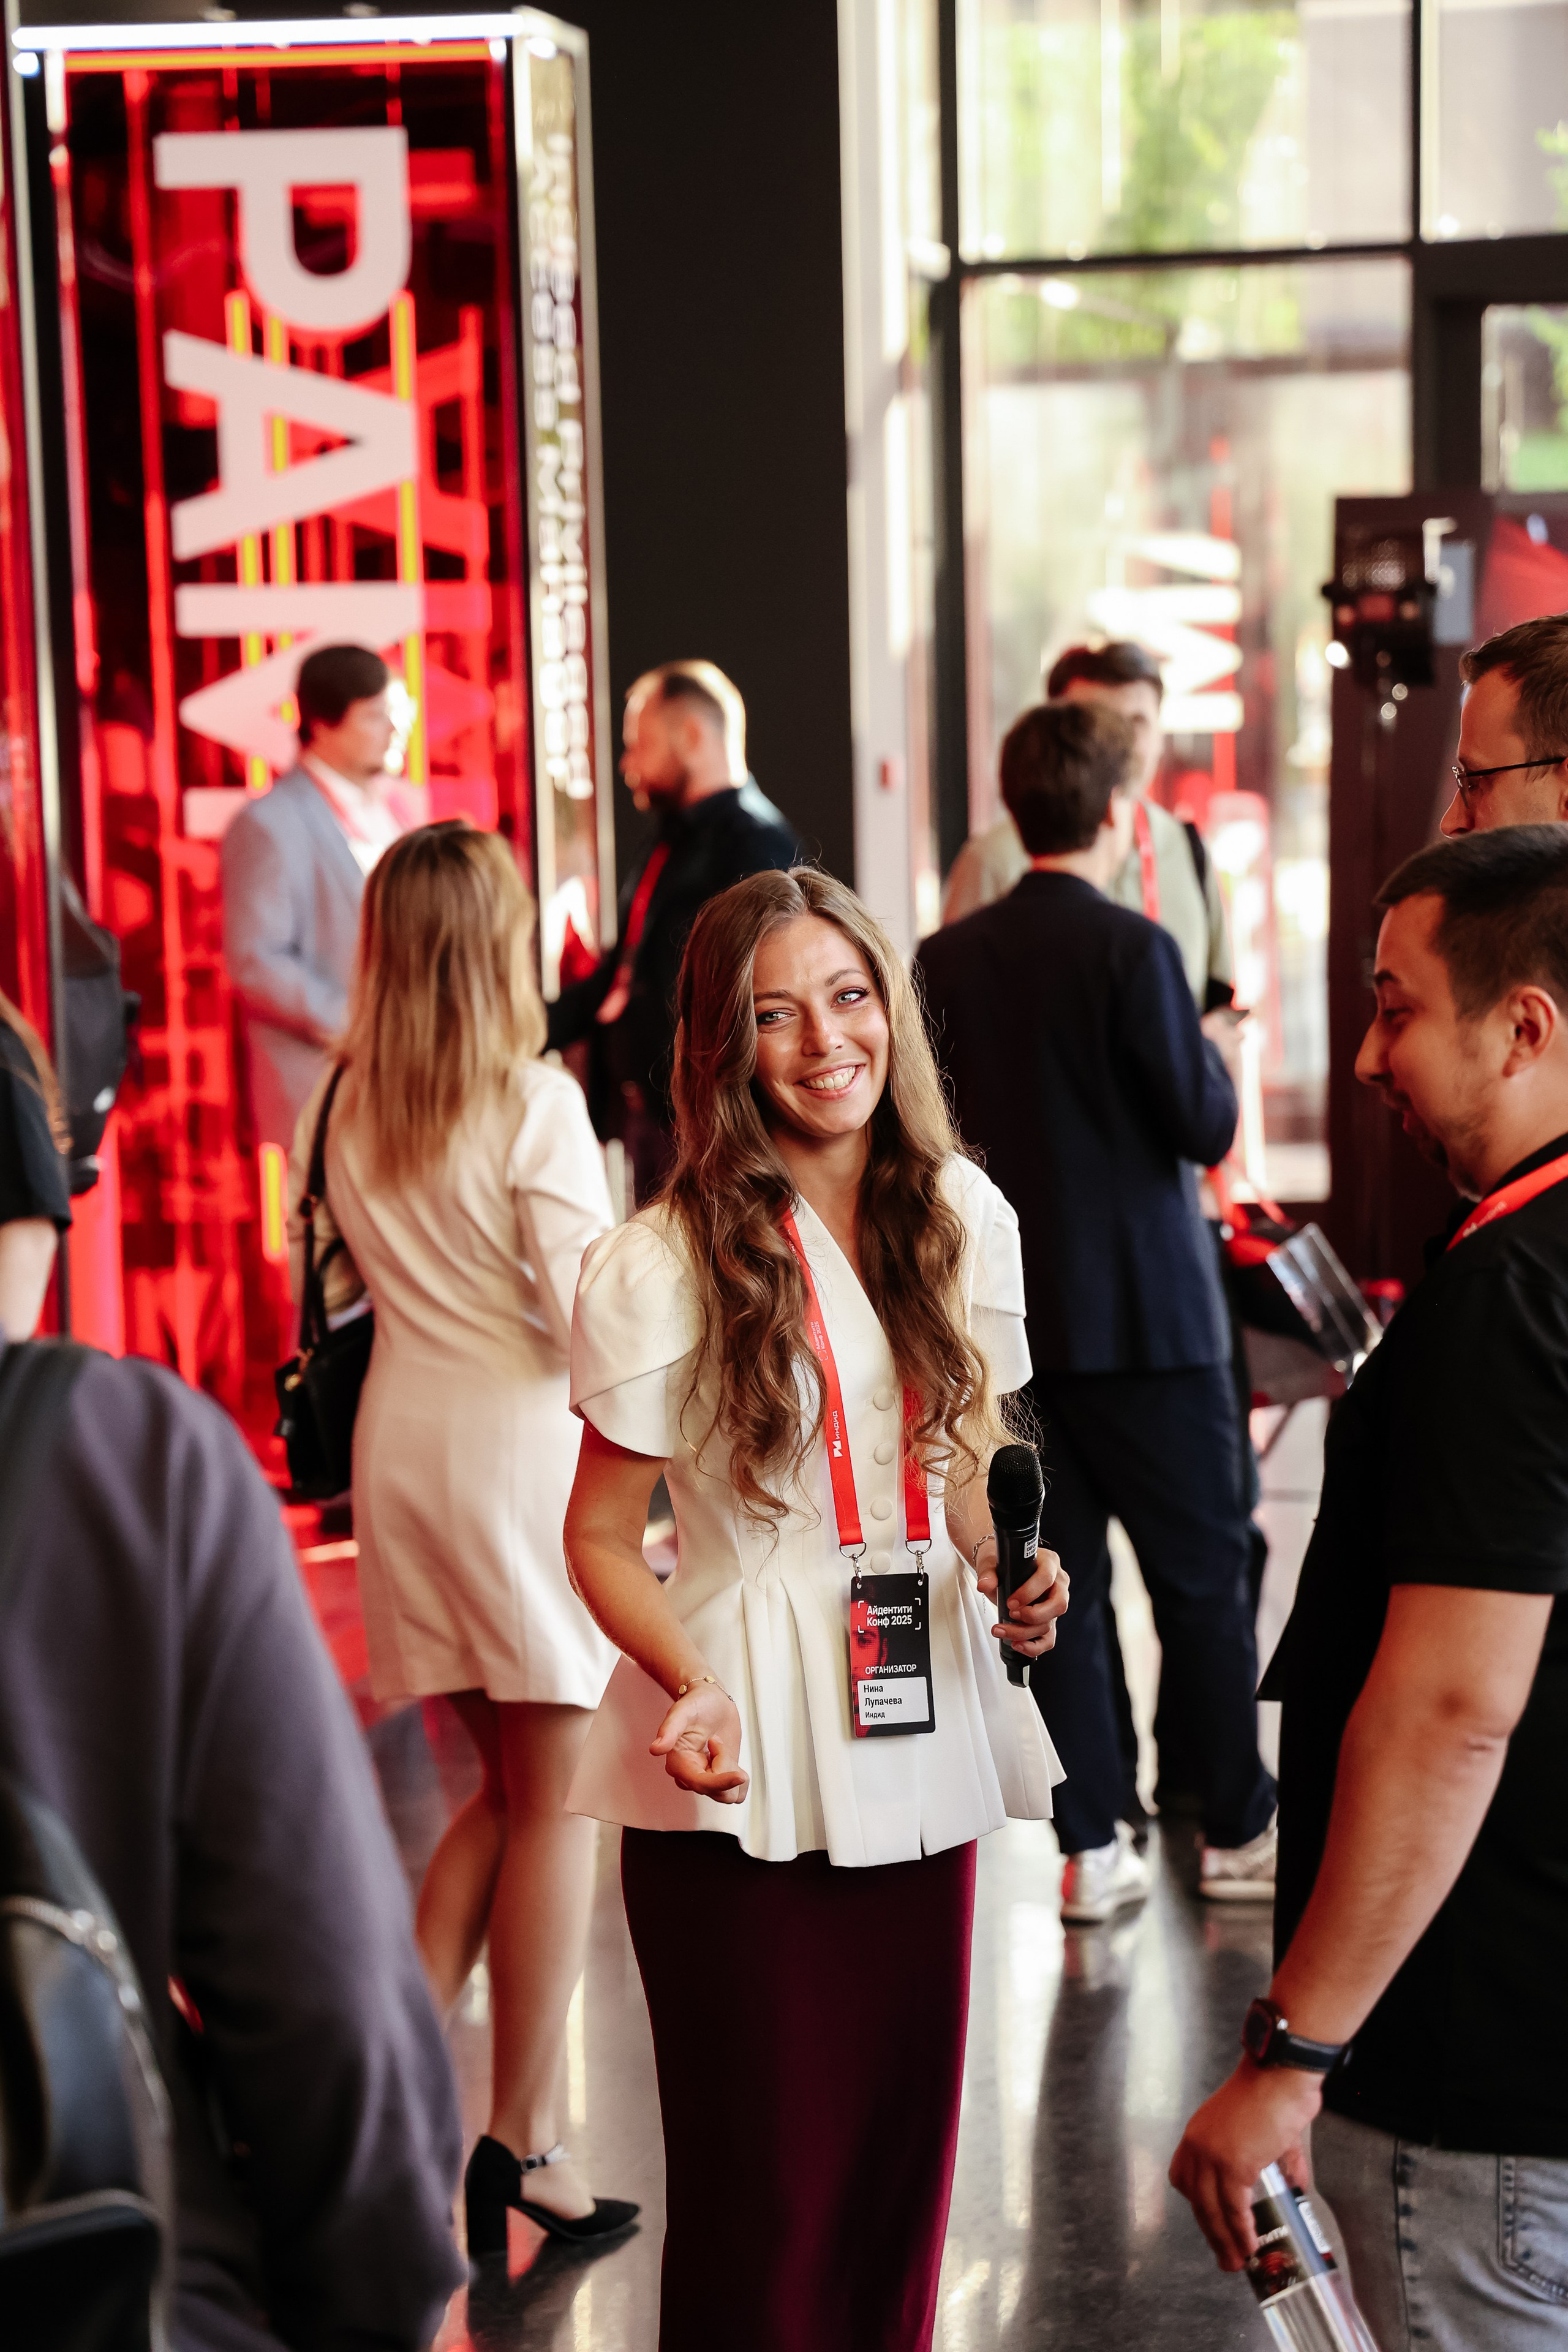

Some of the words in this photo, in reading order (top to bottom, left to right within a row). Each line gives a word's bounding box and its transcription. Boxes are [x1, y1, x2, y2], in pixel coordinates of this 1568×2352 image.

[867, 1605, 913, 1616] Айдентити
[867, 1616, 890, 1629] Конф
[891, 1615, 913, 1626] 2025
[865, 1664, 917, 1675] ОРГАНИЗАТОР
[864, 1684, 884, 1693] Нина
[864, 1697, 903, 1708] Лупачева
